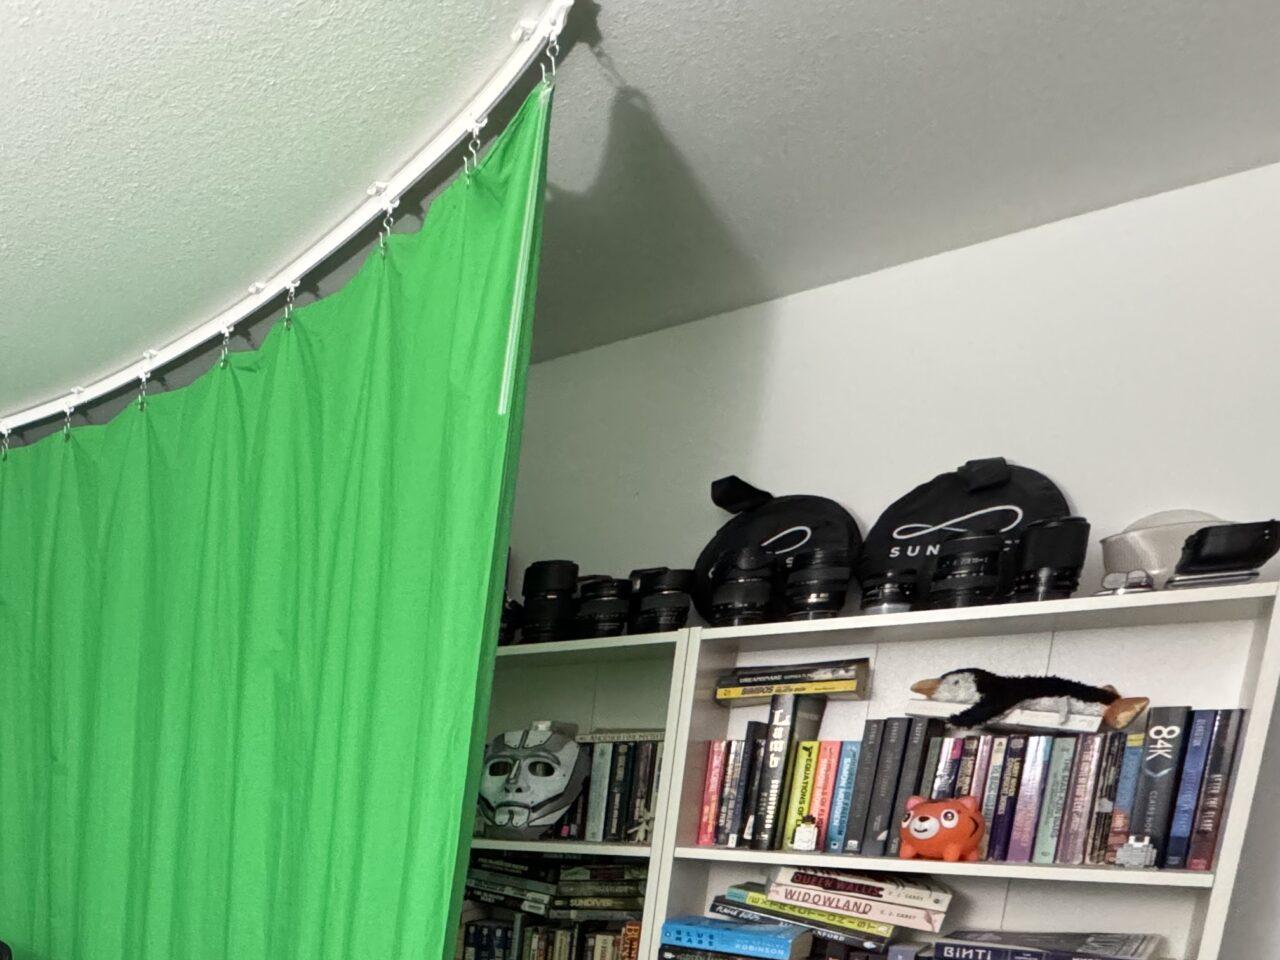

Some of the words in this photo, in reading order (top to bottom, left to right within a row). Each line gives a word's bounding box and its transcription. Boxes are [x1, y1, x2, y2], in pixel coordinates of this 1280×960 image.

[1145, 725, 1181, 761] 84K
[798, 758, 813, 806] EQUATIONS
[784, 890, 879, 918] WIDOWLAND
[675, 929, 715, 940] BLUE
[735, 943, 785, 956] ROBINSON
